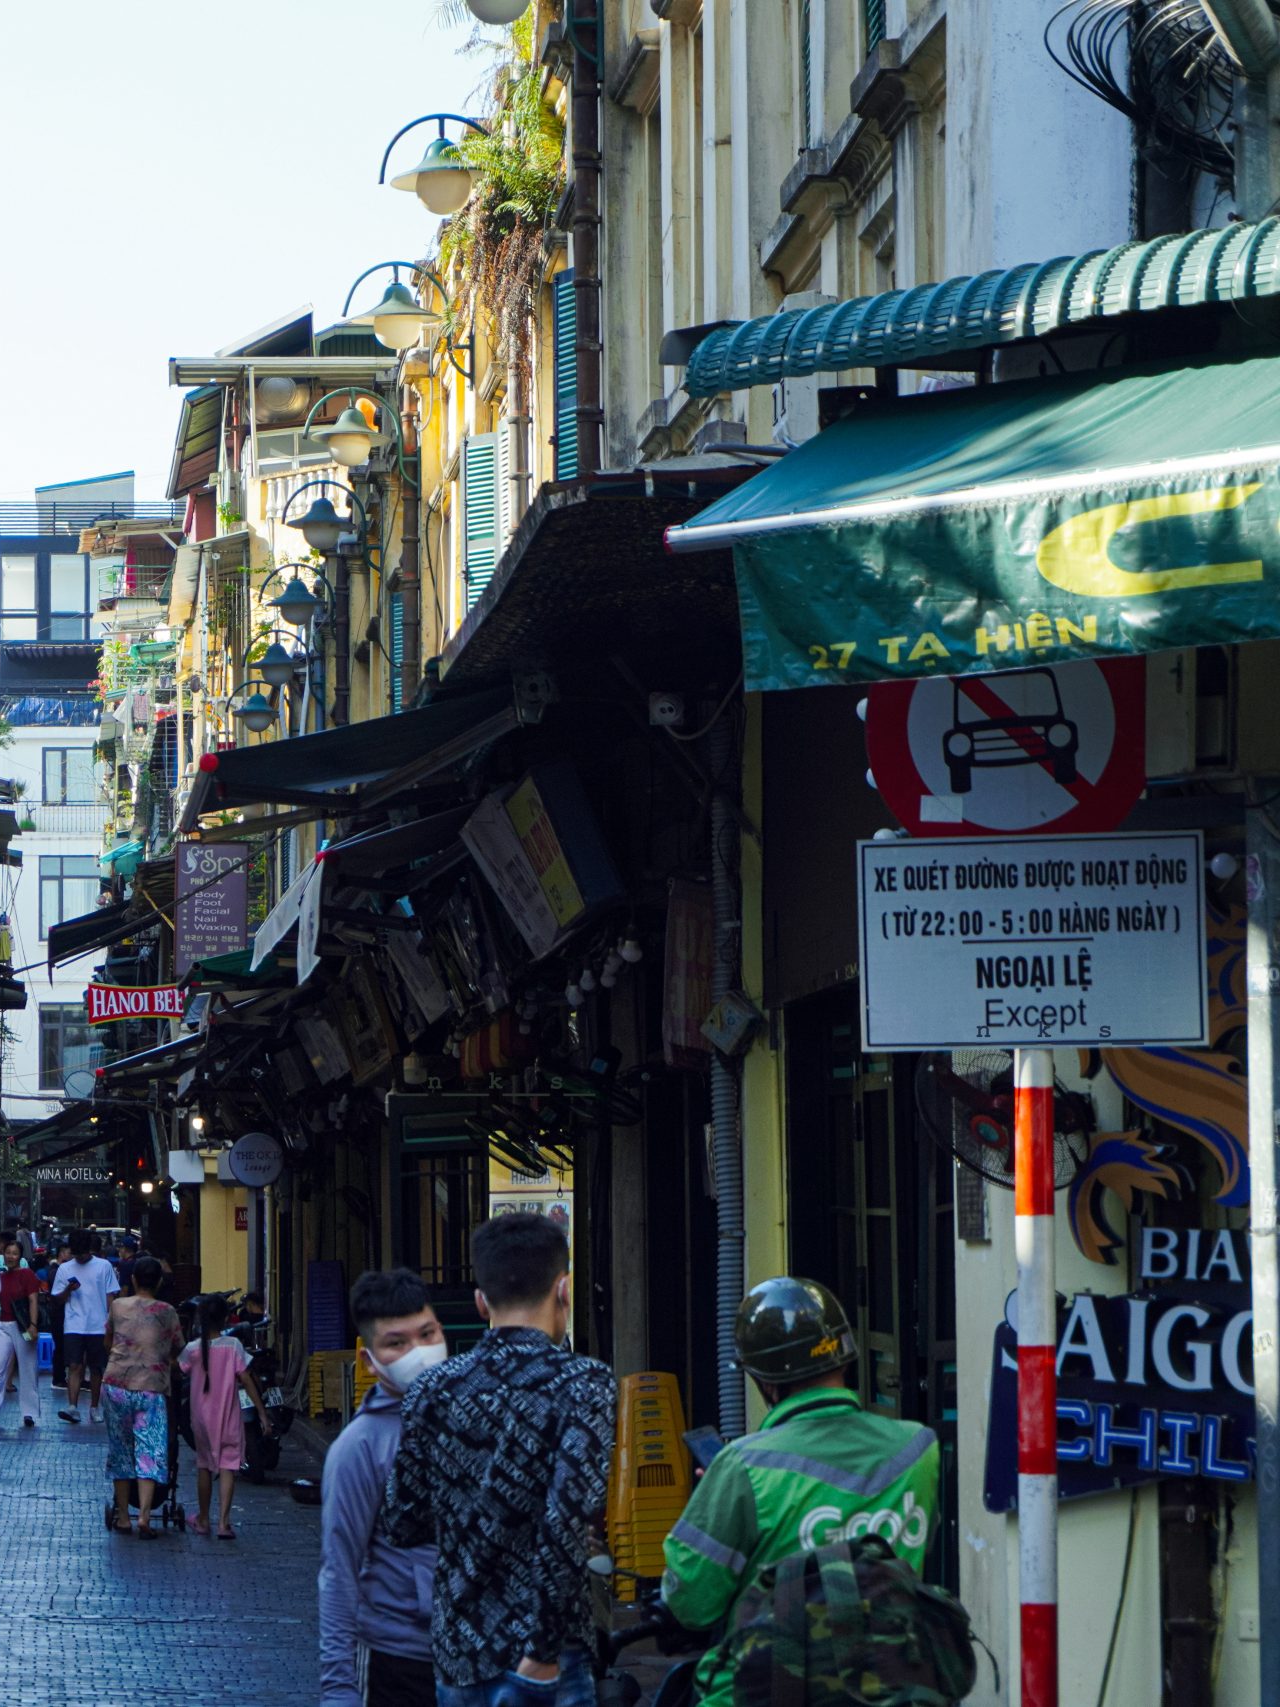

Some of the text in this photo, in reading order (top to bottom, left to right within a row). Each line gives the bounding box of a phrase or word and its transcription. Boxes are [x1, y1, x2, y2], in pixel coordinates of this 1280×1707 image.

[808, 611, 1098, 671] 27 TẠ HIỆN
[874, 853, 1187, 893] XE QUÉT ĐƯỜNG ĐƯỢC HOẠT ĐỘNG
[195, 890, 225, 899] Body
[195, 907, 230, 915] Facial
[1058, 900, 1109, 933] HÀNG
[193, 923, 239, 933] Waxing
[976, 953, 1093, 993] NGOẠI LỆ
[91, 987, 150, 1018] HANOI
[985, 999, 1087, 1030] Except
[36, 1168, 62, 1180] MINA
[64, 1167, 94, 1181] HOTEL
[1142, 1227, 1242, 1282] BIA
[1056, 1398, 1257, 1480] CHIL
